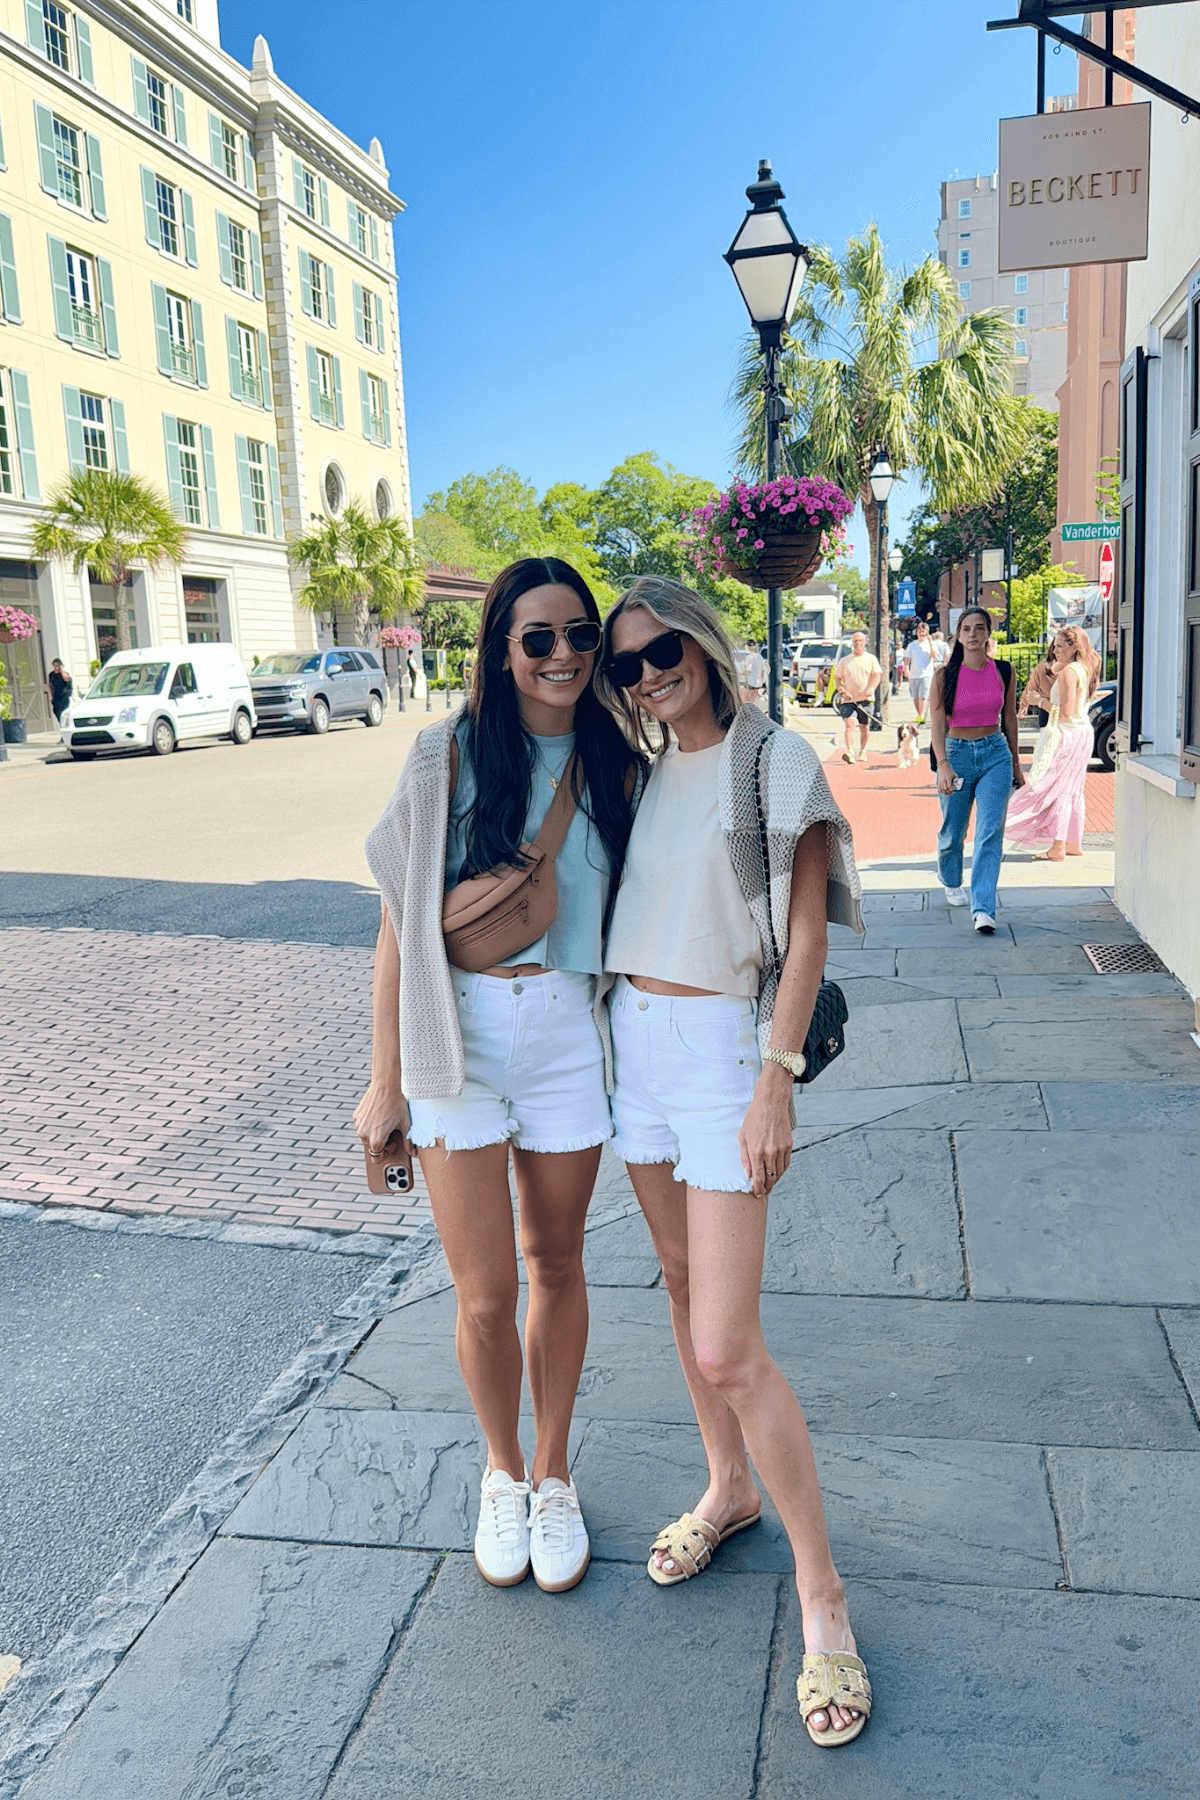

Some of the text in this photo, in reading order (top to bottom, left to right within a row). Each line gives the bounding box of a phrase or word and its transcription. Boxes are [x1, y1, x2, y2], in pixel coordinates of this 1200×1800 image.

[1064, 130, 1087, 138] KING
[1008, 168, 1142, 207] BECKETT
[1049, 236, 1096, 246] BOUTIQUE
[1065, 525, 1120, 538] Vanderhor
